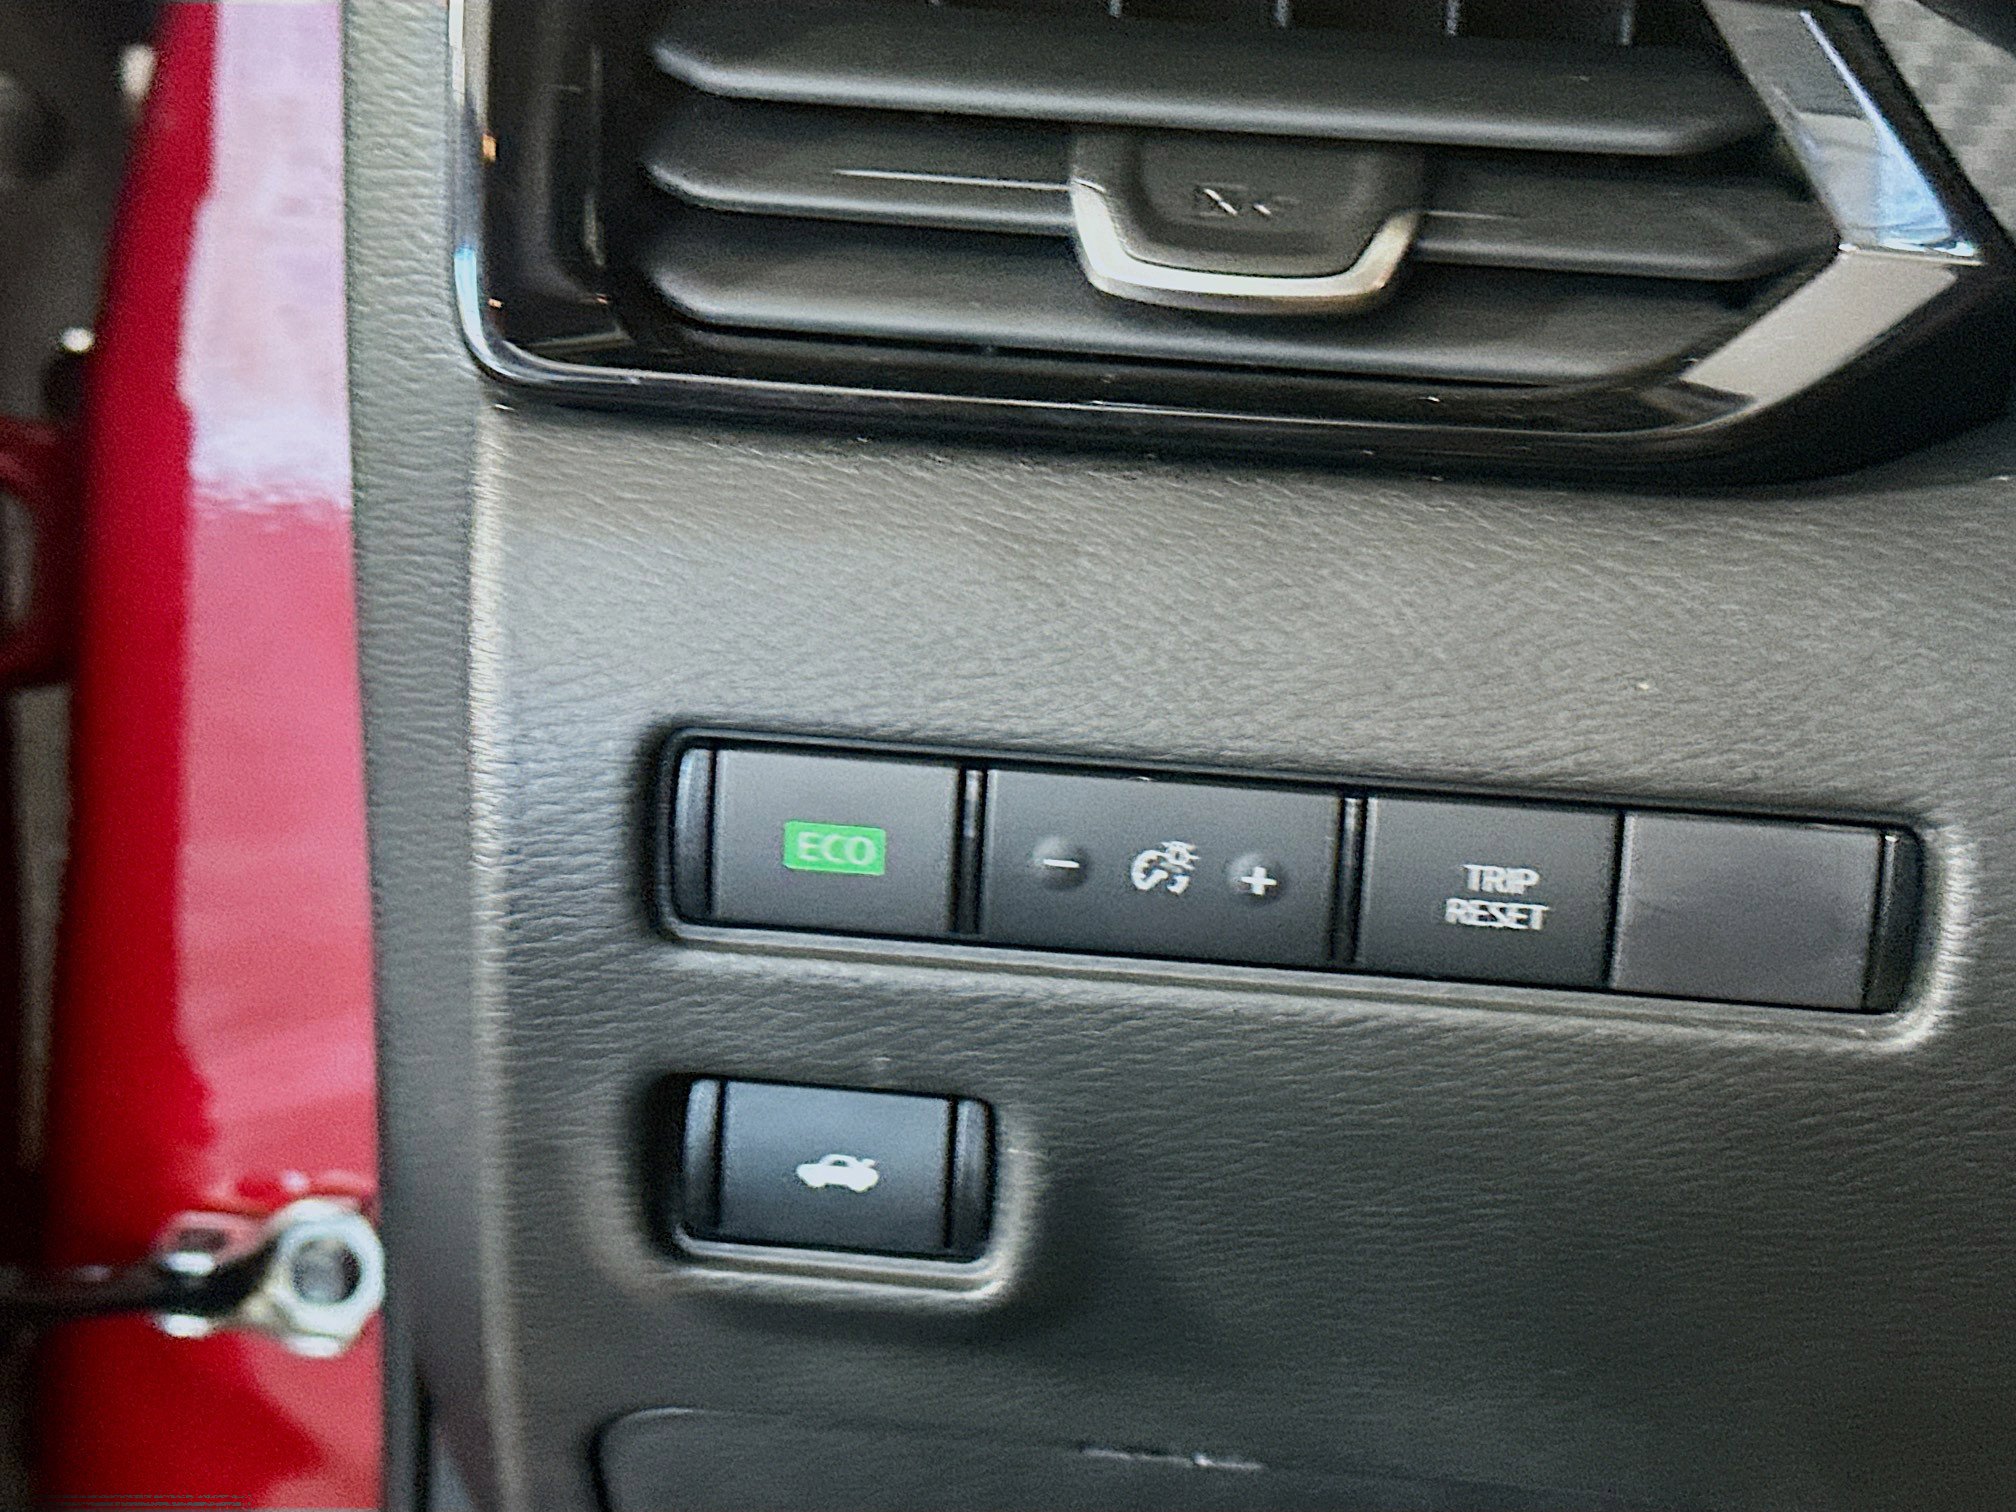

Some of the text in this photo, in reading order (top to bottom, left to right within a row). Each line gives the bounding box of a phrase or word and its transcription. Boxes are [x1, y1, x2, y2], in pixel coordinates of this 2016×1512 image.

[797, 831, 876, 866] ECO
[1461, 864, 1540, 894] TRIP
[1445, 898, 1550, 930] RESET
